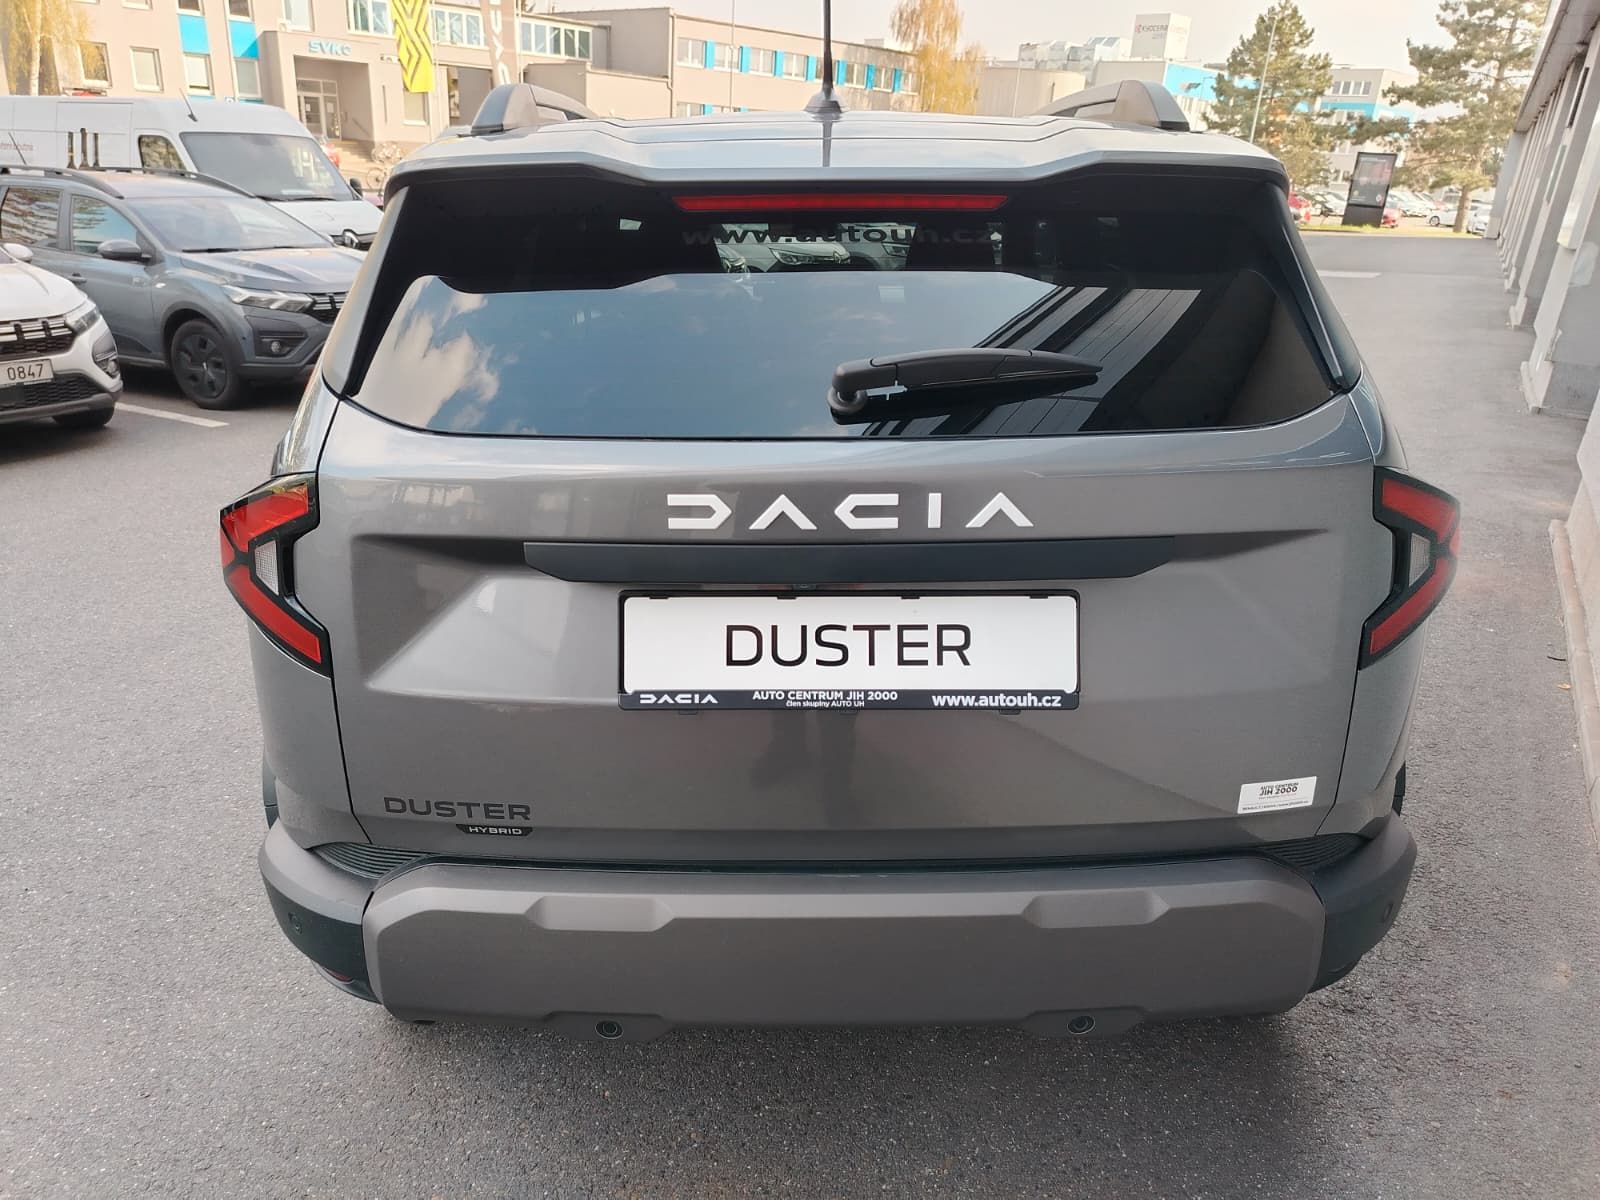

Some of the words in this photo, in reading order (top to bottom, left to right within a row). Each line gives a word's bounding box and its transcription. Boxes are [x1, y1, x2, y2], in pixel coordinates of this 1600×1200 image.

[7, 363, 44, 381] 0847
[667, 491, 1034, 530] DACIA
[725, 624, 971, 667] DUSTER
[639, 693, 719, 704] DACIA
[752, 691, 785, 701] AUTO
[787, 691, 844, 701] CENTRUM
[846, 691, 865, 701] JIH
[867, 691, 898, 701] 2000
[931, 692, 1062, 707] www.autouh.cz
[1275, 786, 1298, 795] 2000
[383, 796, 531, 821] DUSTER
[469, 826, 522, 835] HYBRID
